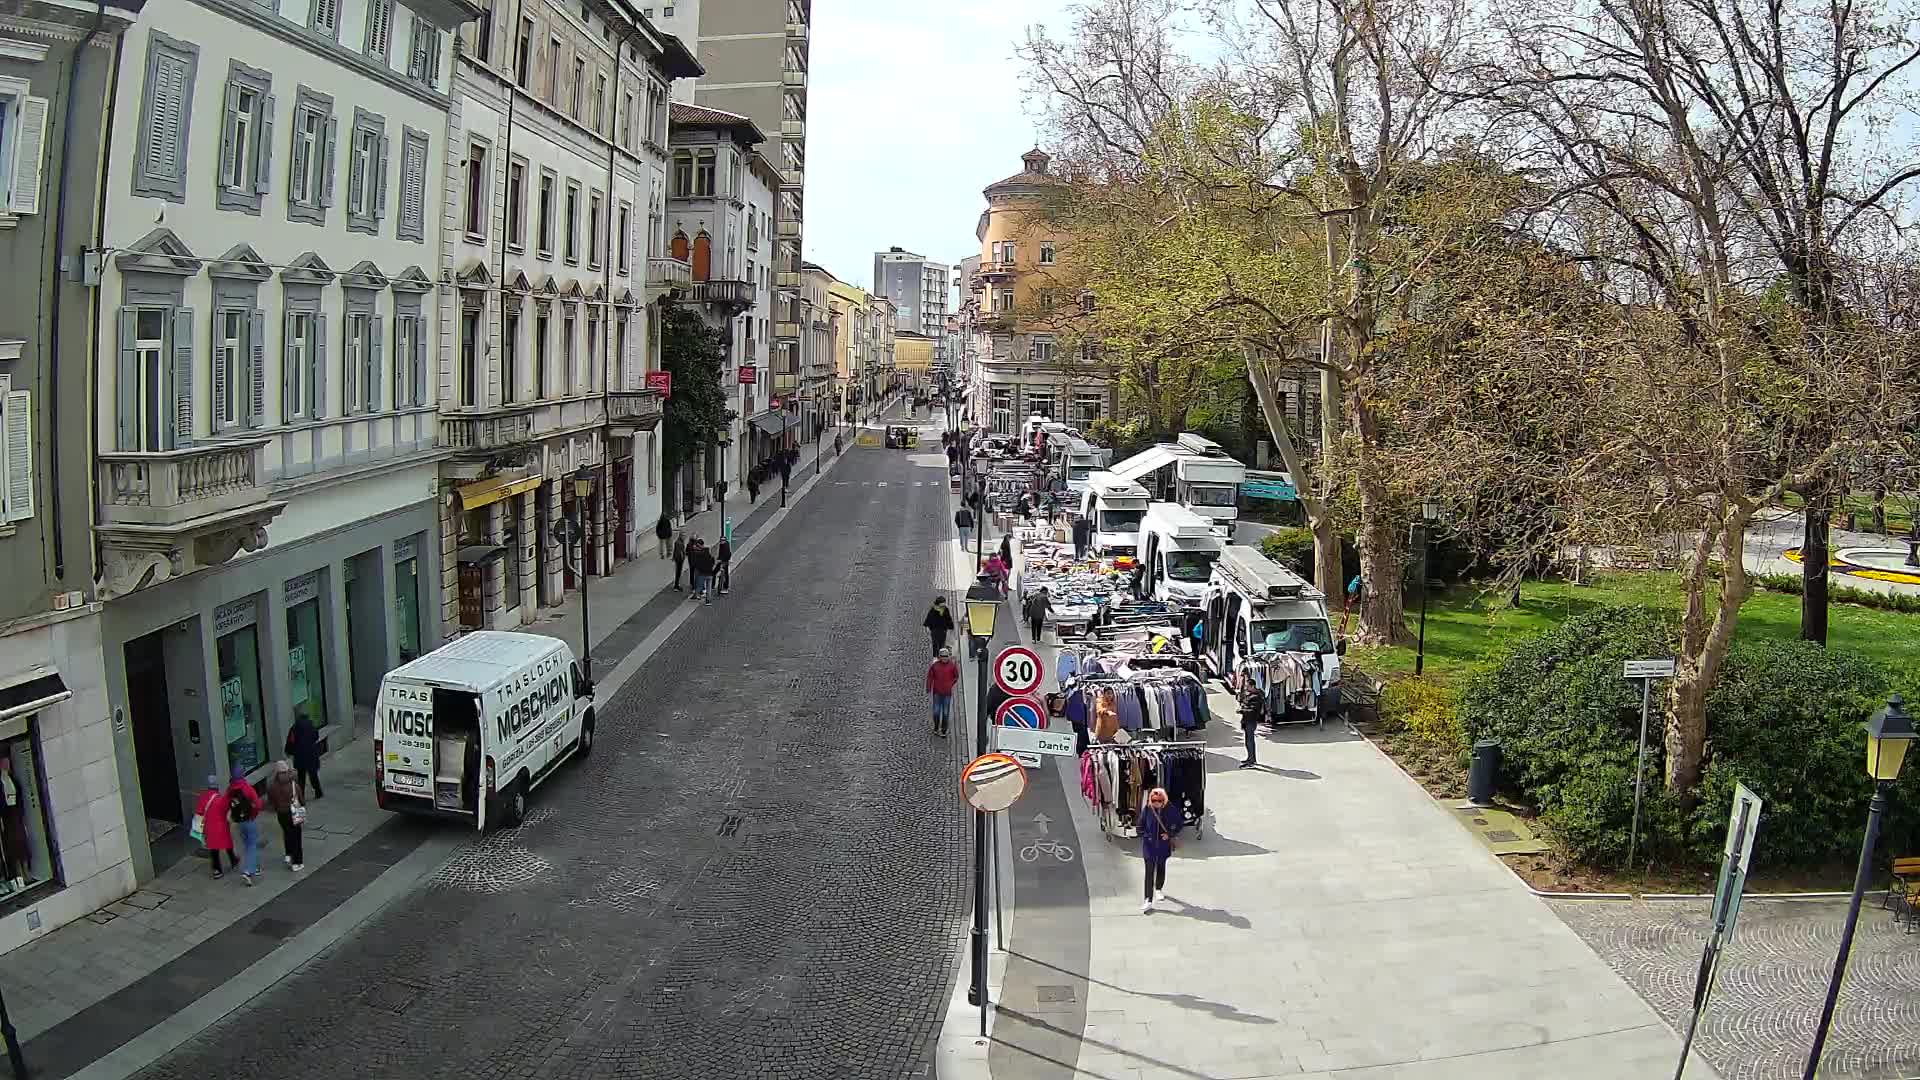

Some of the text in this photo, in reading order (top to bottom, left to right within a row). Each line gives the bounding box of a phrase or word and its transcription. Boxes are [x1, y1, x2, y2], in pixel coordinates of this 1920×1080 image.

[496, 651, 564, 704] TRASLOCHI
[1005, 660, 1033, 683] 30
[496, 671, 569, 745] MOSCHION
[1038, 740, 1071, 752] Dante
